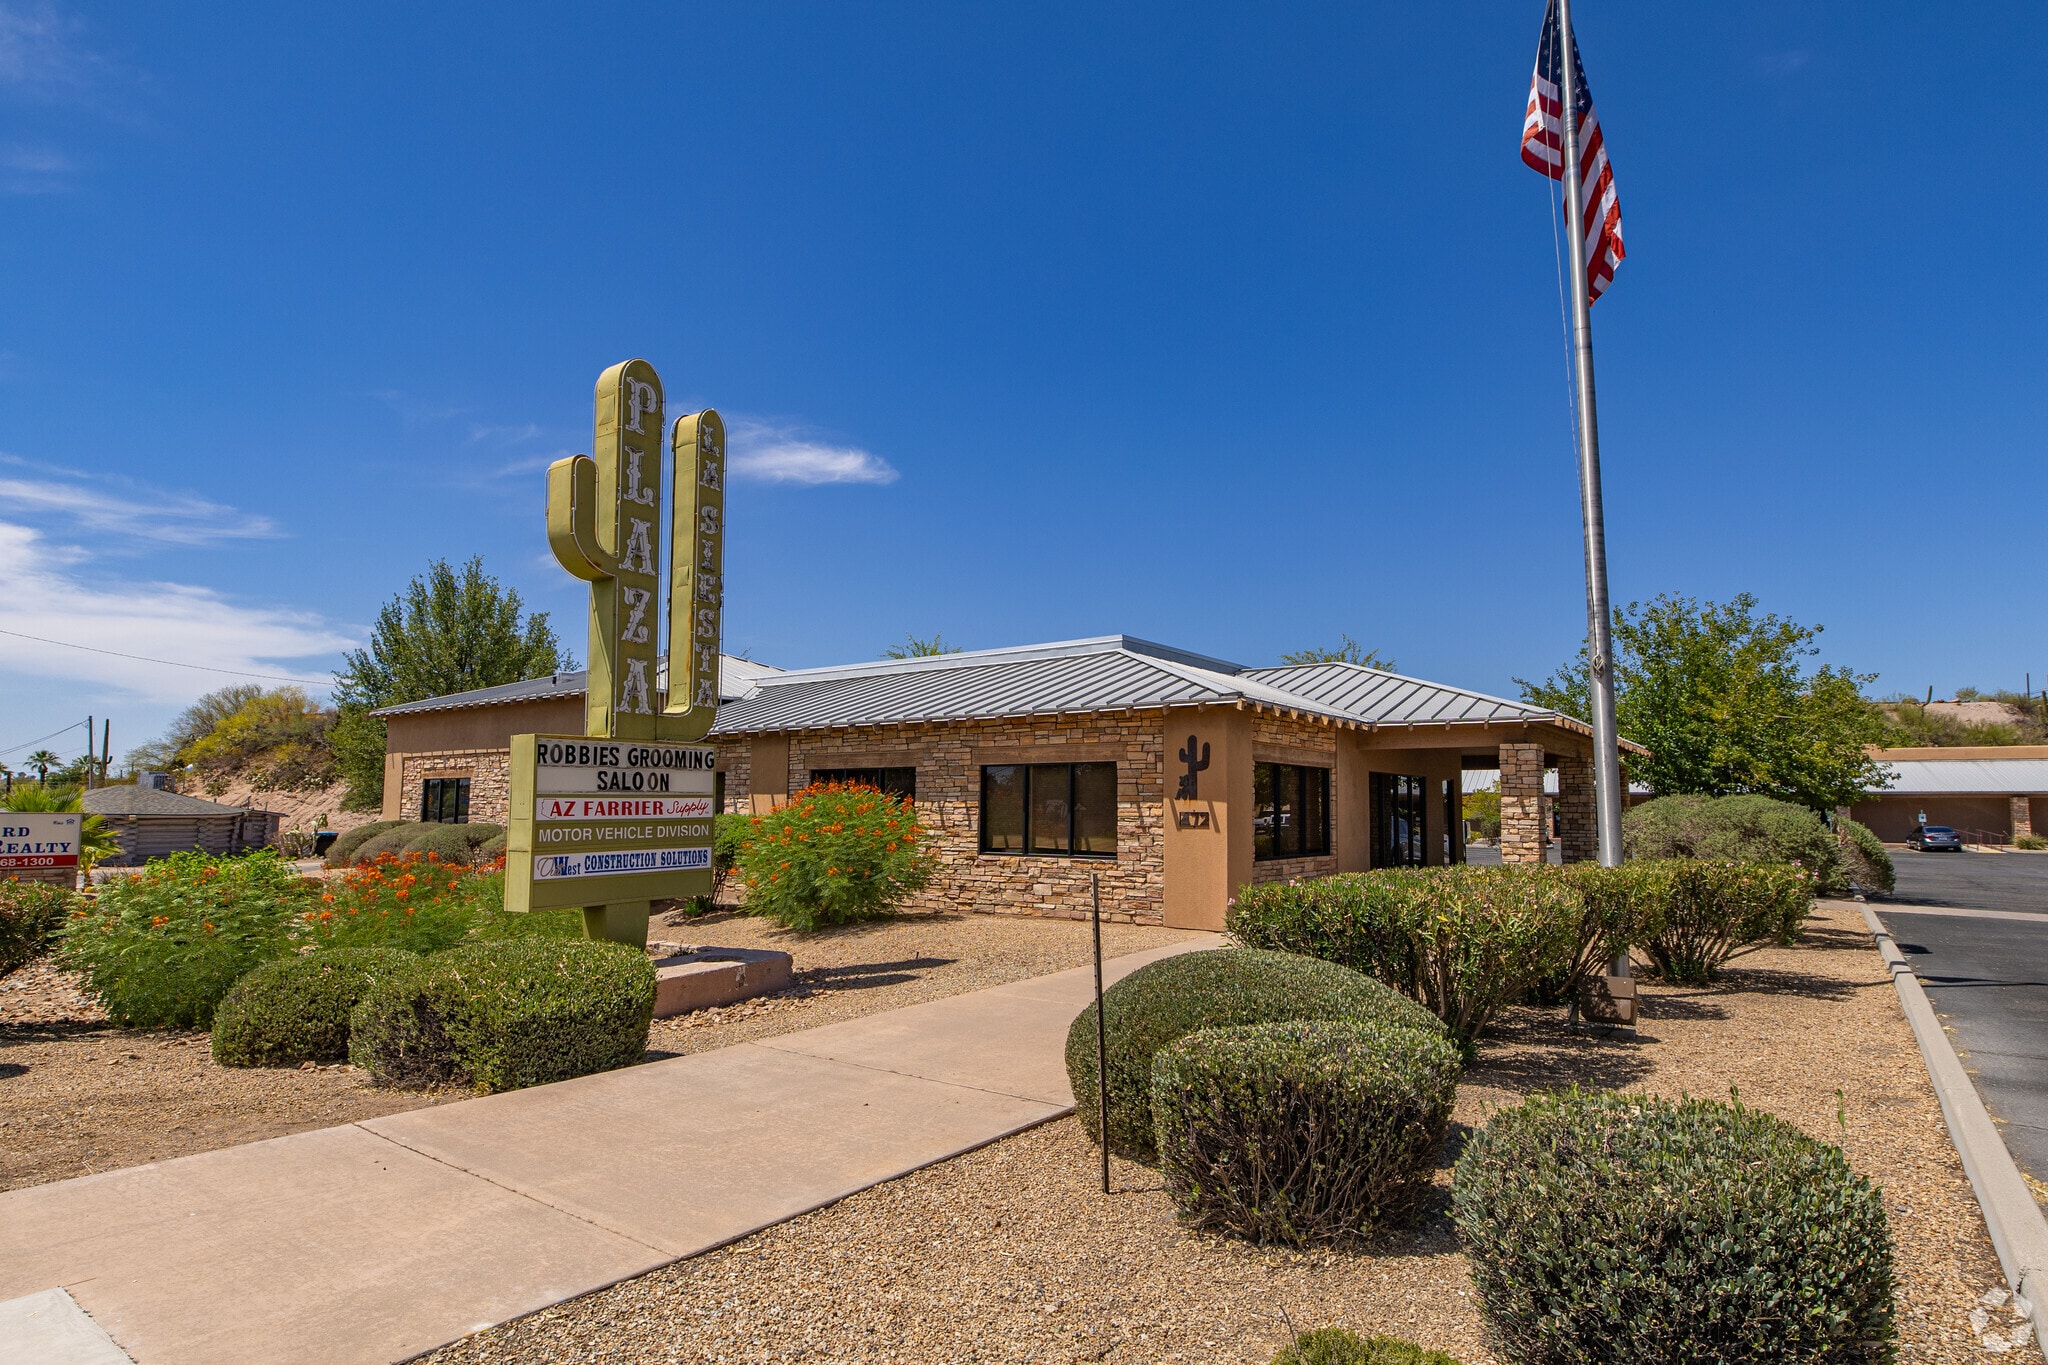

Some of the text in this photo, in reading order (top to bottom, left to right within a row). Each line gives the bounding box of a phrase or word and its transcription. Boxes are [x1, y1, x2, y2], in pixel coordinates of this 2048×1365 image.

[617, 376, 659, 715] PLAZA
[694, 424, 721, 708] LA SIESTA
[538, 743, 714, 769] ROBBIES GROOMING
[597, 771, 670, 792] SALOON
[550, 799, 709, 818] AZ FARRIER Supply
[539, 824, 709, 842] MOTOR VEHICLE DIVISION
[584, 852, 656, 871] CONSTRUCTION
[660, 849, 708, 867] SOLUTIONS
